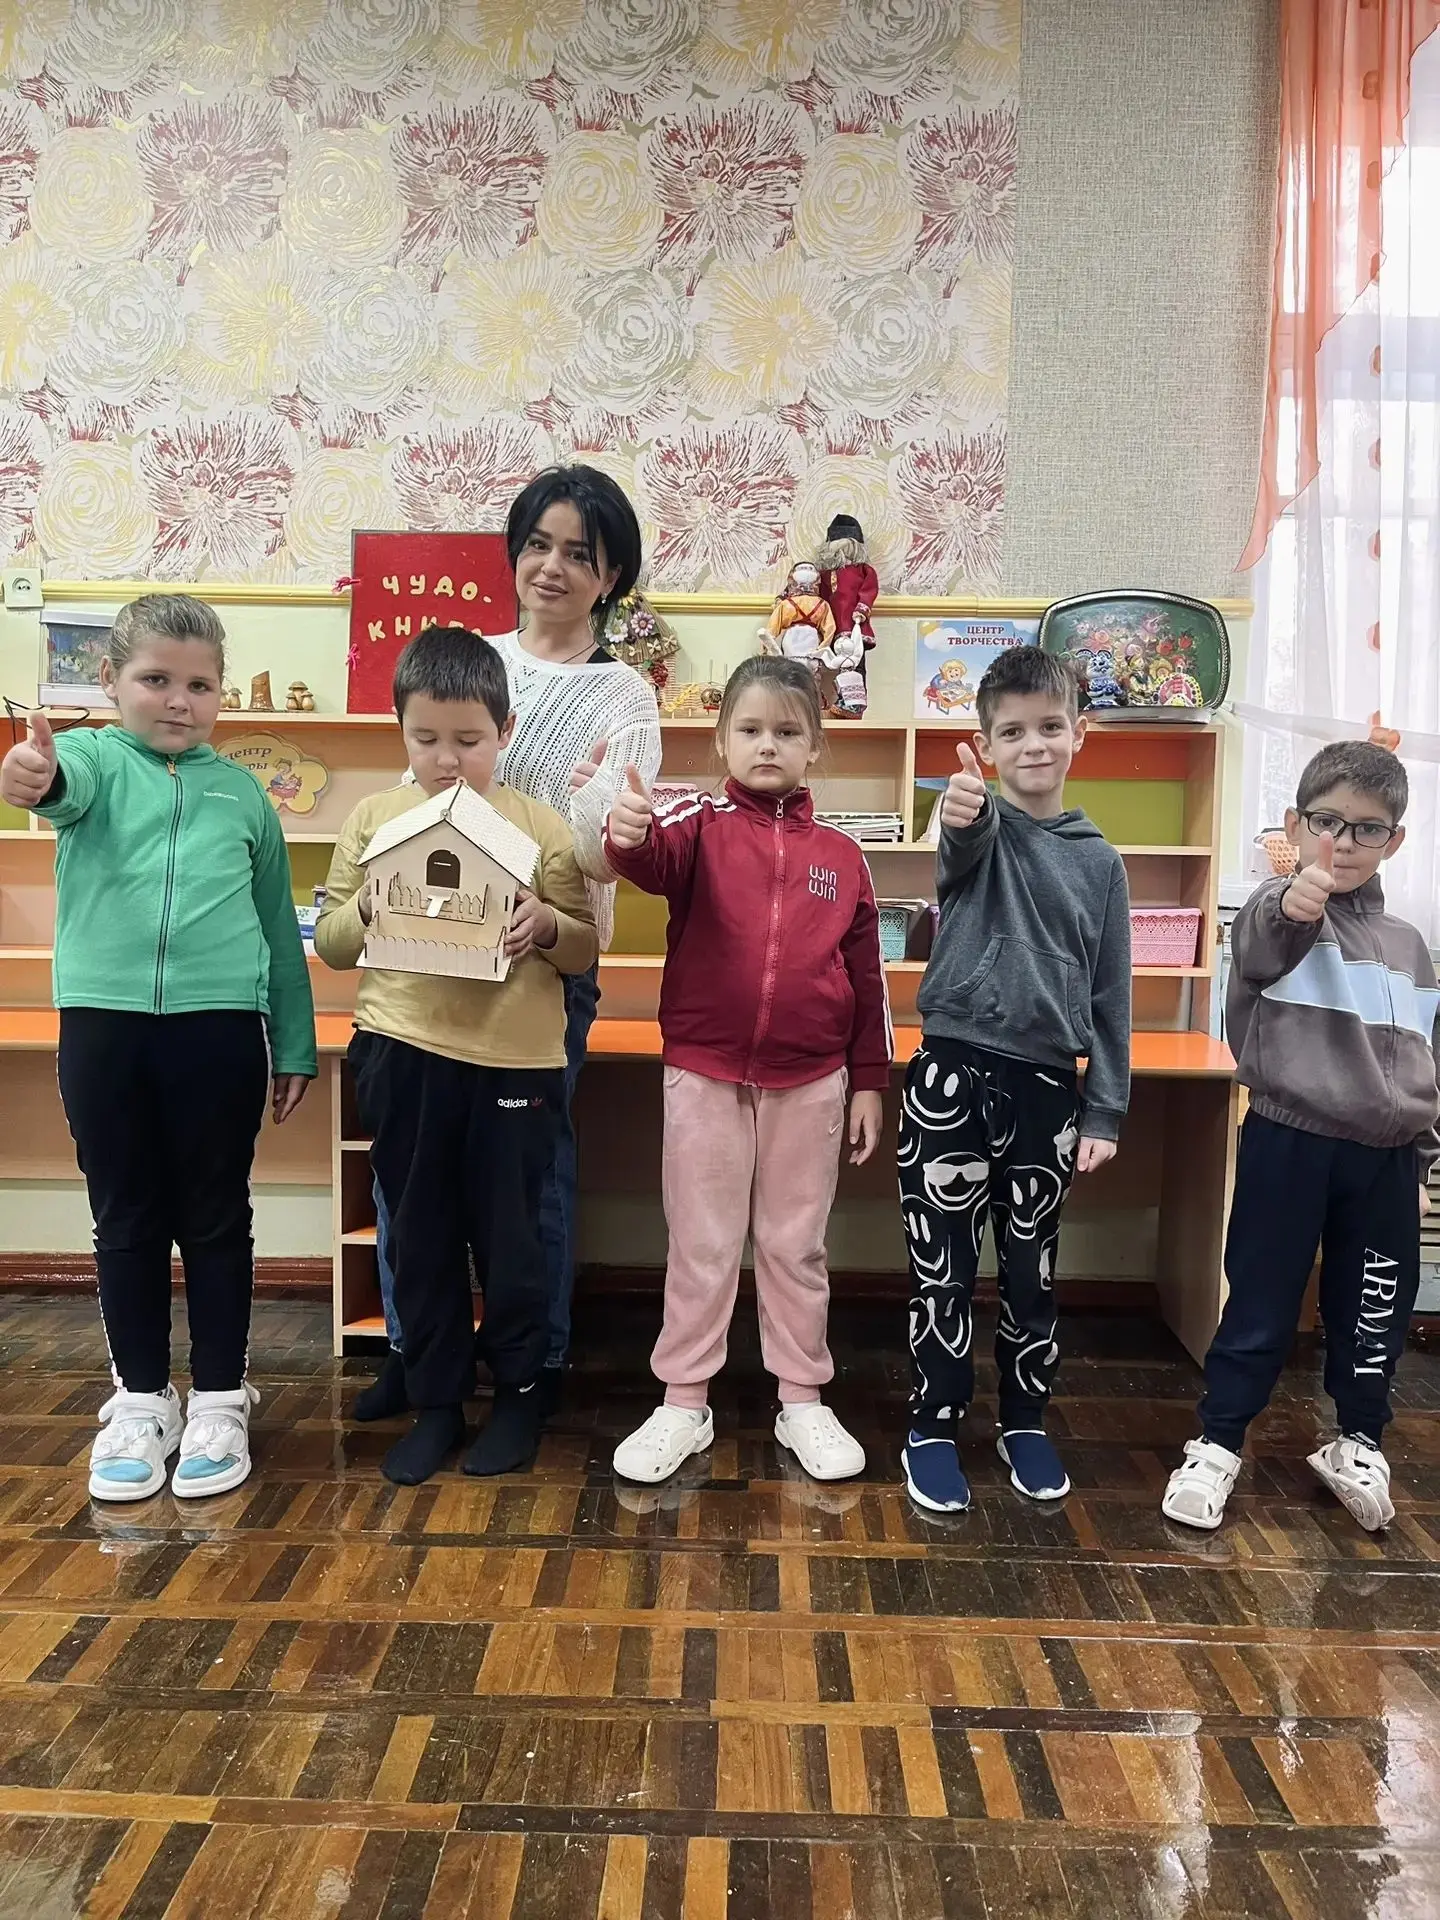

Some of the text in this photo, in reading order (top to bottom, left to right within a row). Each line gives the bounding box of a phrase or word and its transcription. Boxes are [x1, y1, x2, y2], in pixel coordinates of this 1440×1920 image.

[382, 574, 492, 603] ЧУДО.
[966, 626, 1005, 635] ЦЕНТР
[947, 637, 1024, 646] ТВОРЧЕСТВА
[497, 1098, 529, 1109] adidas
